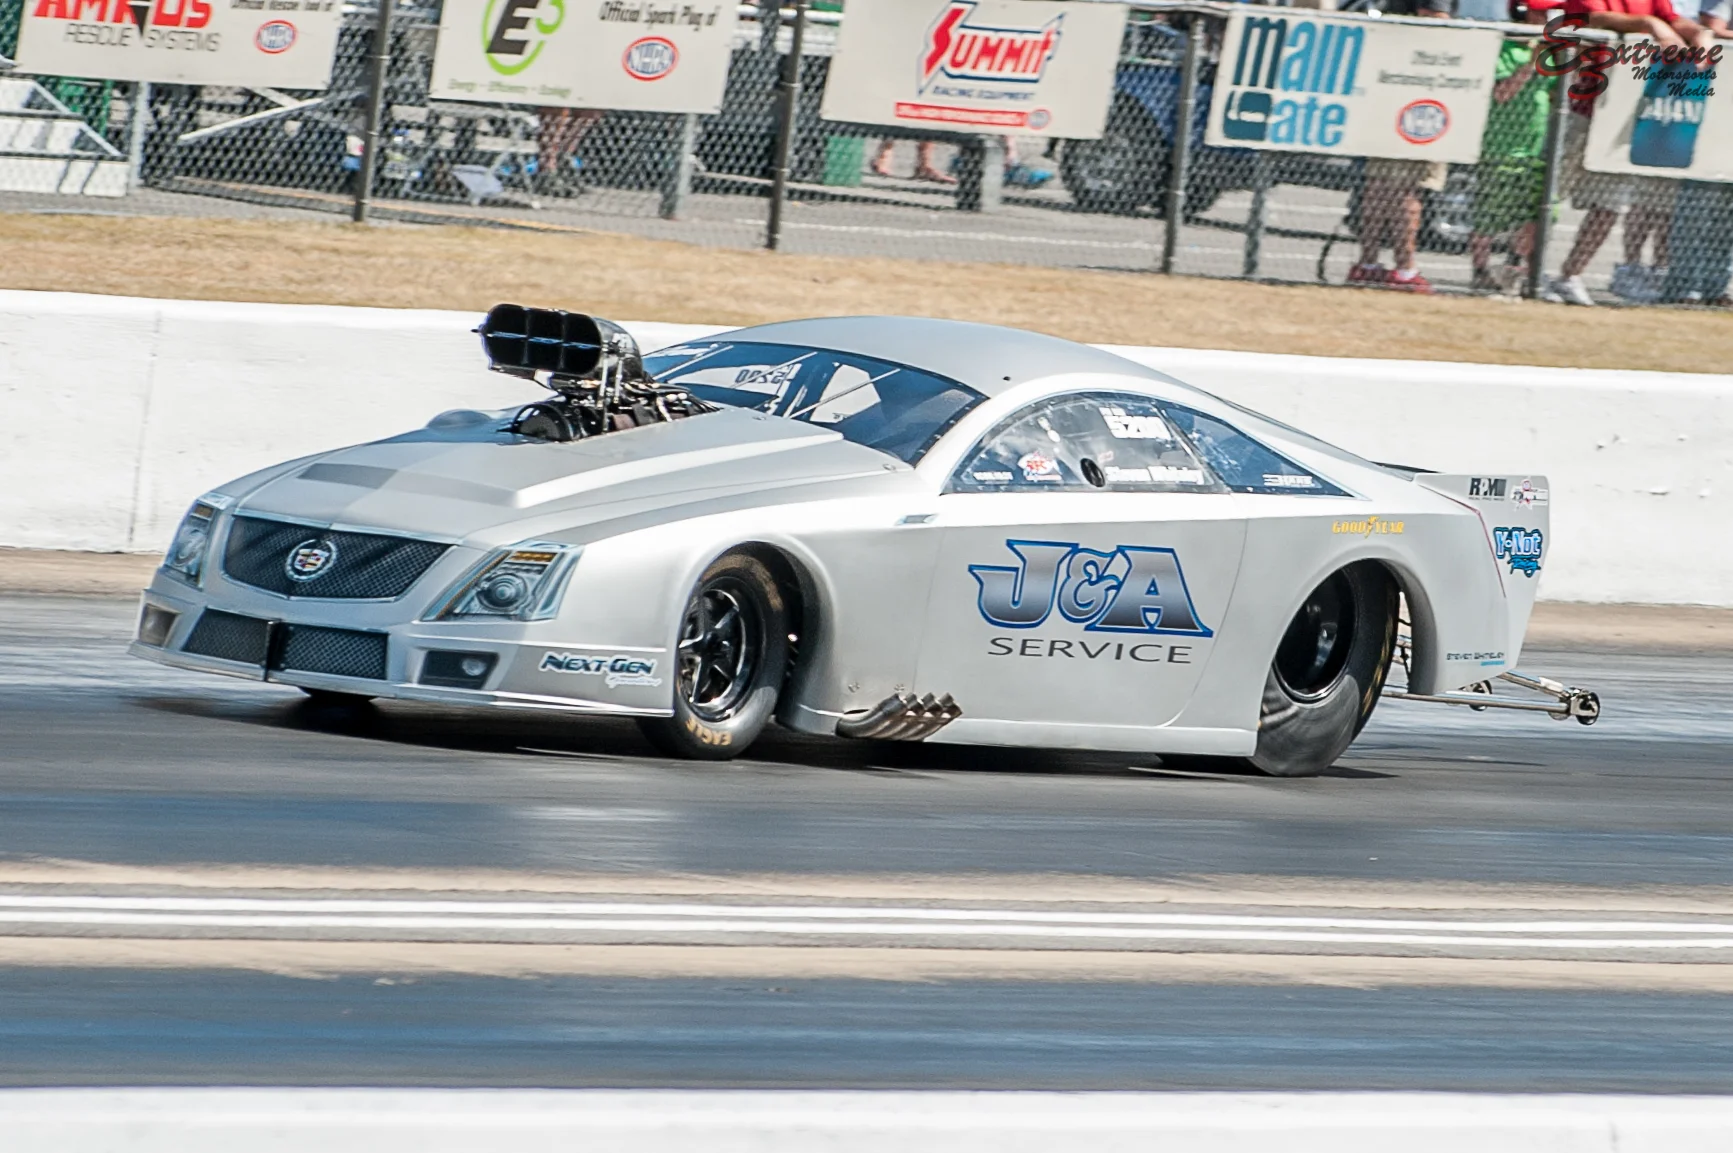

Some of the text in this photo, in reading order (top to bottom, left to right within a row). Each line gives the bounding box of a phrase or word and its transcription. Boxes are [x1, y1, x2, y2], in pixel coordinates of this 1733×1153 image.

[65, 22, 133, 46] RESCUE
[968, 538, 1214, 638] J&A
[987, 636, 1194, 664] SERVICE
